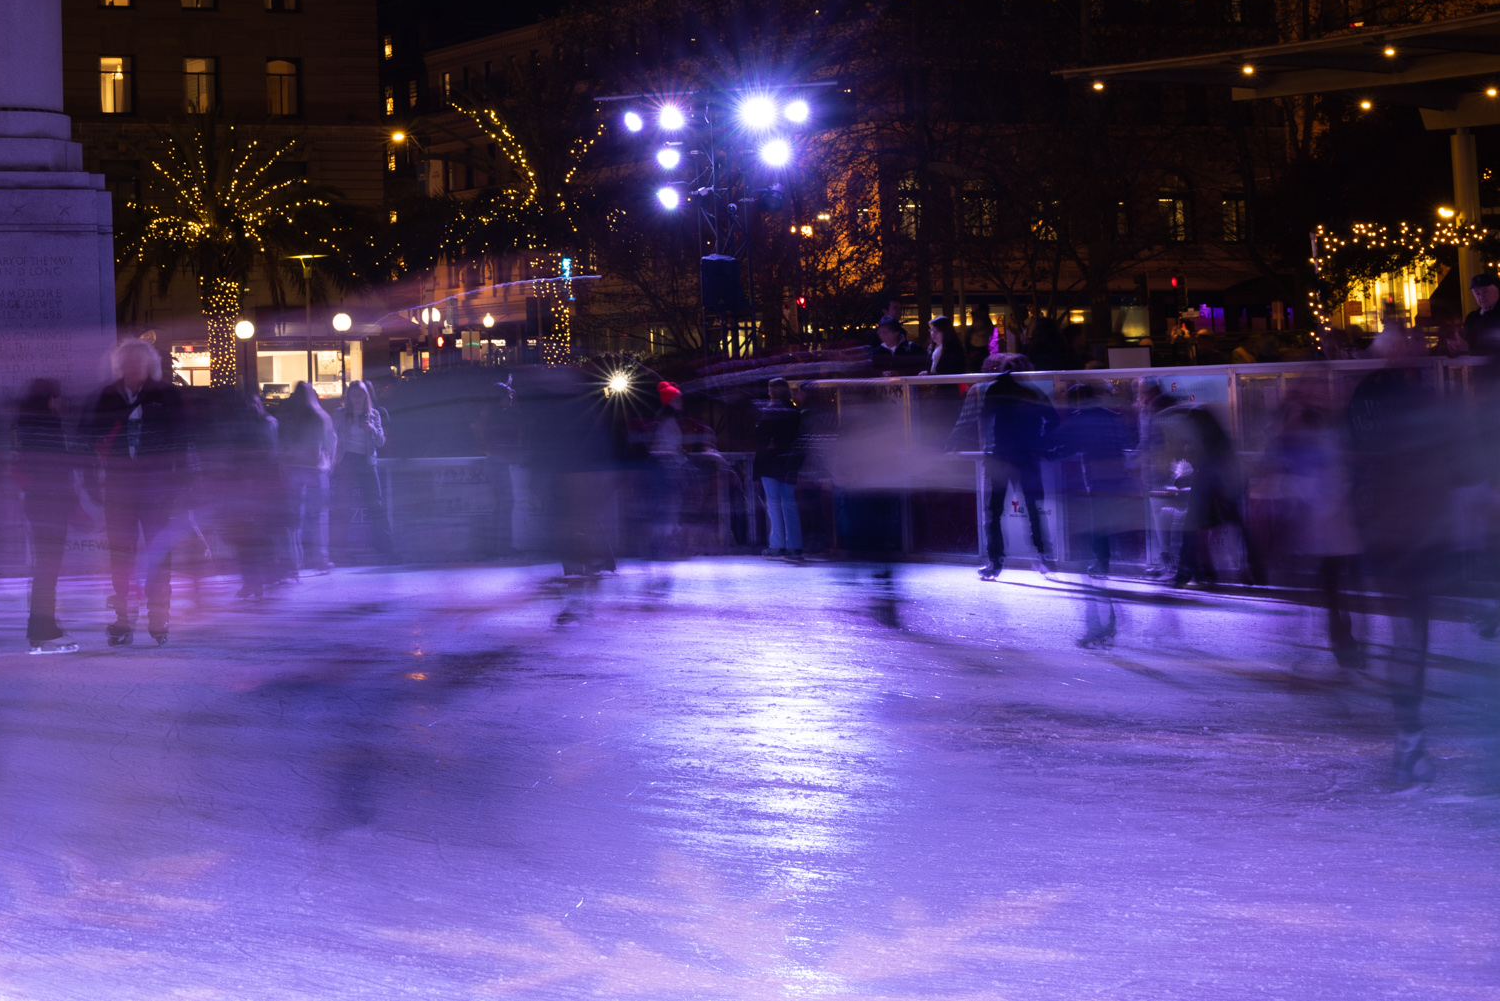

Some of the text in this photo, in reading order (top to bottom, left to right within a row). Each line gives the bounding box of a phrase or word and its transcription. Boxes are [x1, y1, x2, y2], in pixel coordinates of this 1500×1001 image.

[15, 256, 29, 266] OF
[30, 256, 48, 266] THE
[50, 256, 74, 265] NAVY
[29, 267, 62, 276] LONG
[25, 300, 62, 309] DEWEY
[65, 540, 109, 552] SAFEW
